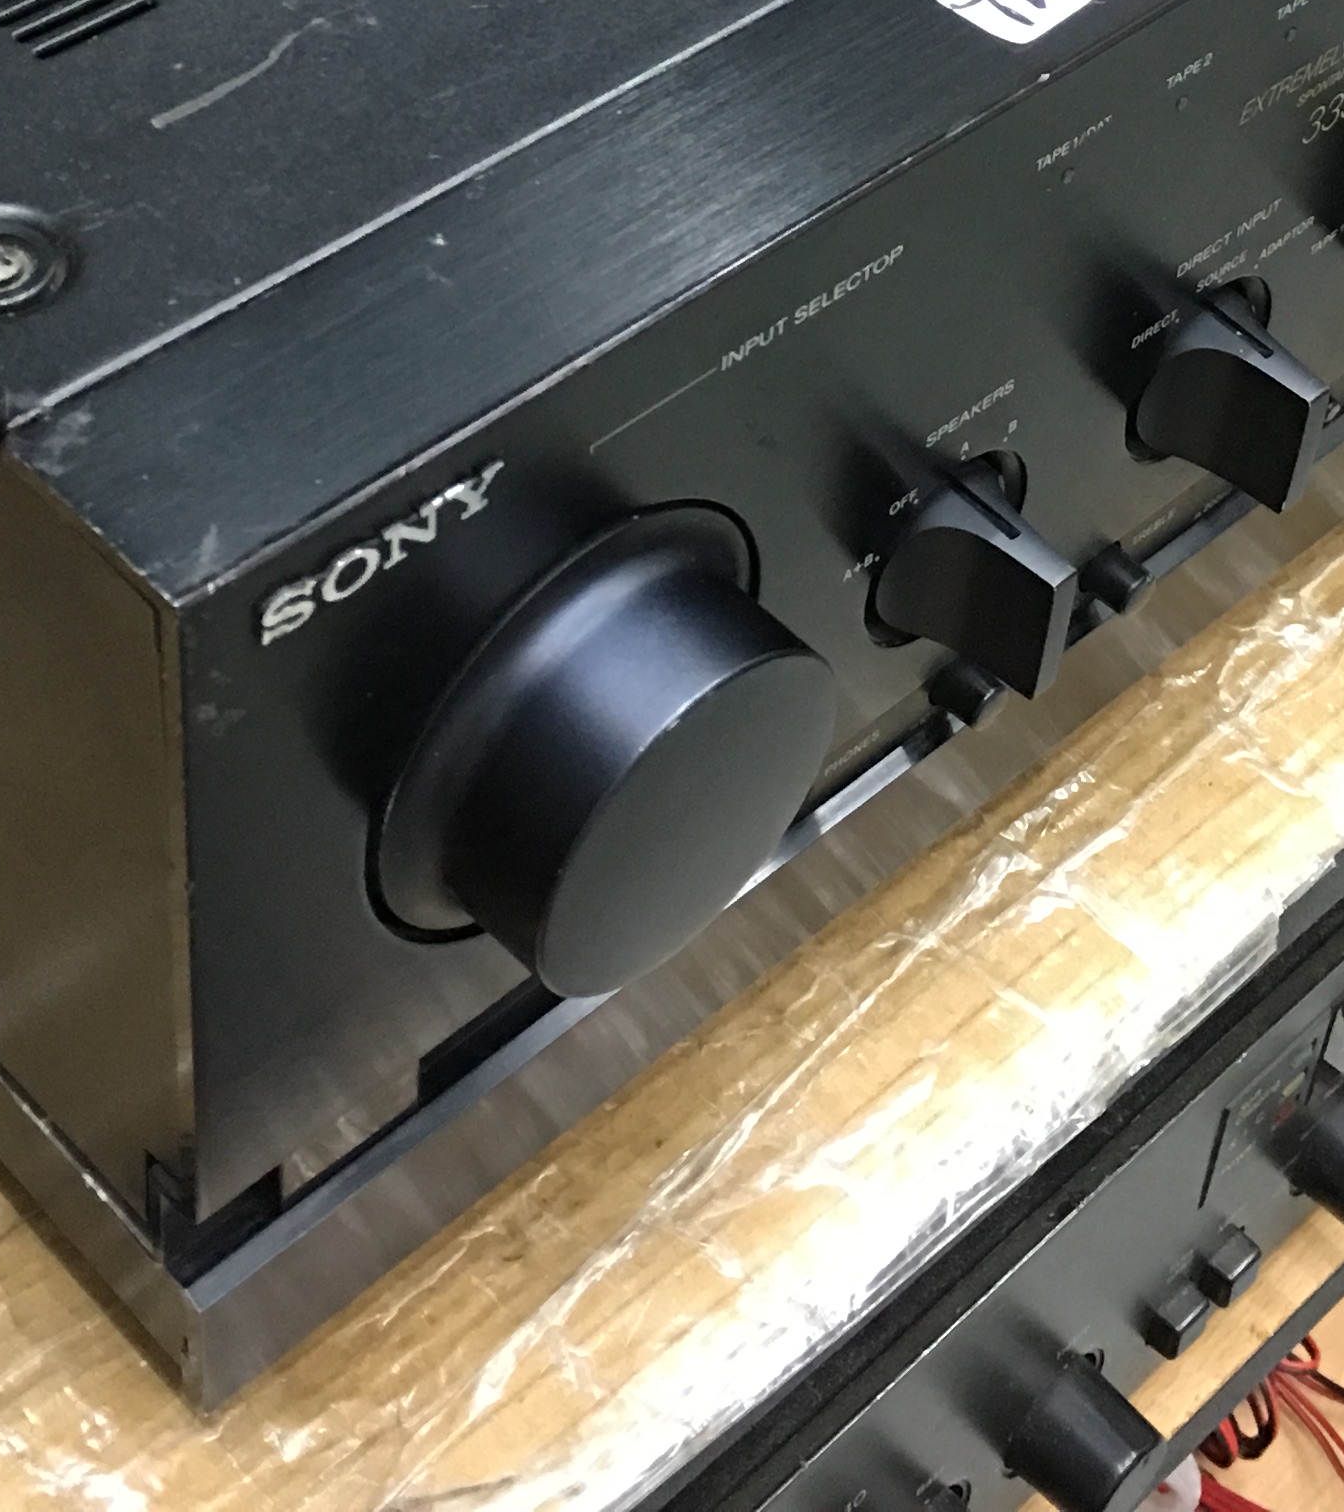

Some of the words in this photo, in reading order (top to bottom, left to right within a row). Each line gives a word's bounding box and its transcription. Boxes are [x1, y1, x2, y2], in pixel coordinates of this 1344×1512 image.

[1166, 60, 1201, 89] TAPE
[1203, 52, 1213, 67] 2
[1036, 143, 1070, 171] TAPE
[1177, 231, 1233, 278] DIRECT
[1236, 197, 1283, 237] INPUT
[1258, 215, 1315, 261] ADAPTOR
[1195, 249, 1249, 293] SOURCE
[721, 316, 789, 371] INPUT
[1131, 309, 1178, 350] DIRECT
[925, 379, 1015, 448] SPEAKERS
[1007, 419, 1018, 434] B
[960, 441, 970, 456] A
[889, 488, 919, 516] OFF
[261, 460, 504, 646] SONY
[842, 553, 874, 582] A+B
[824, 729, 880, 777] PHONES
